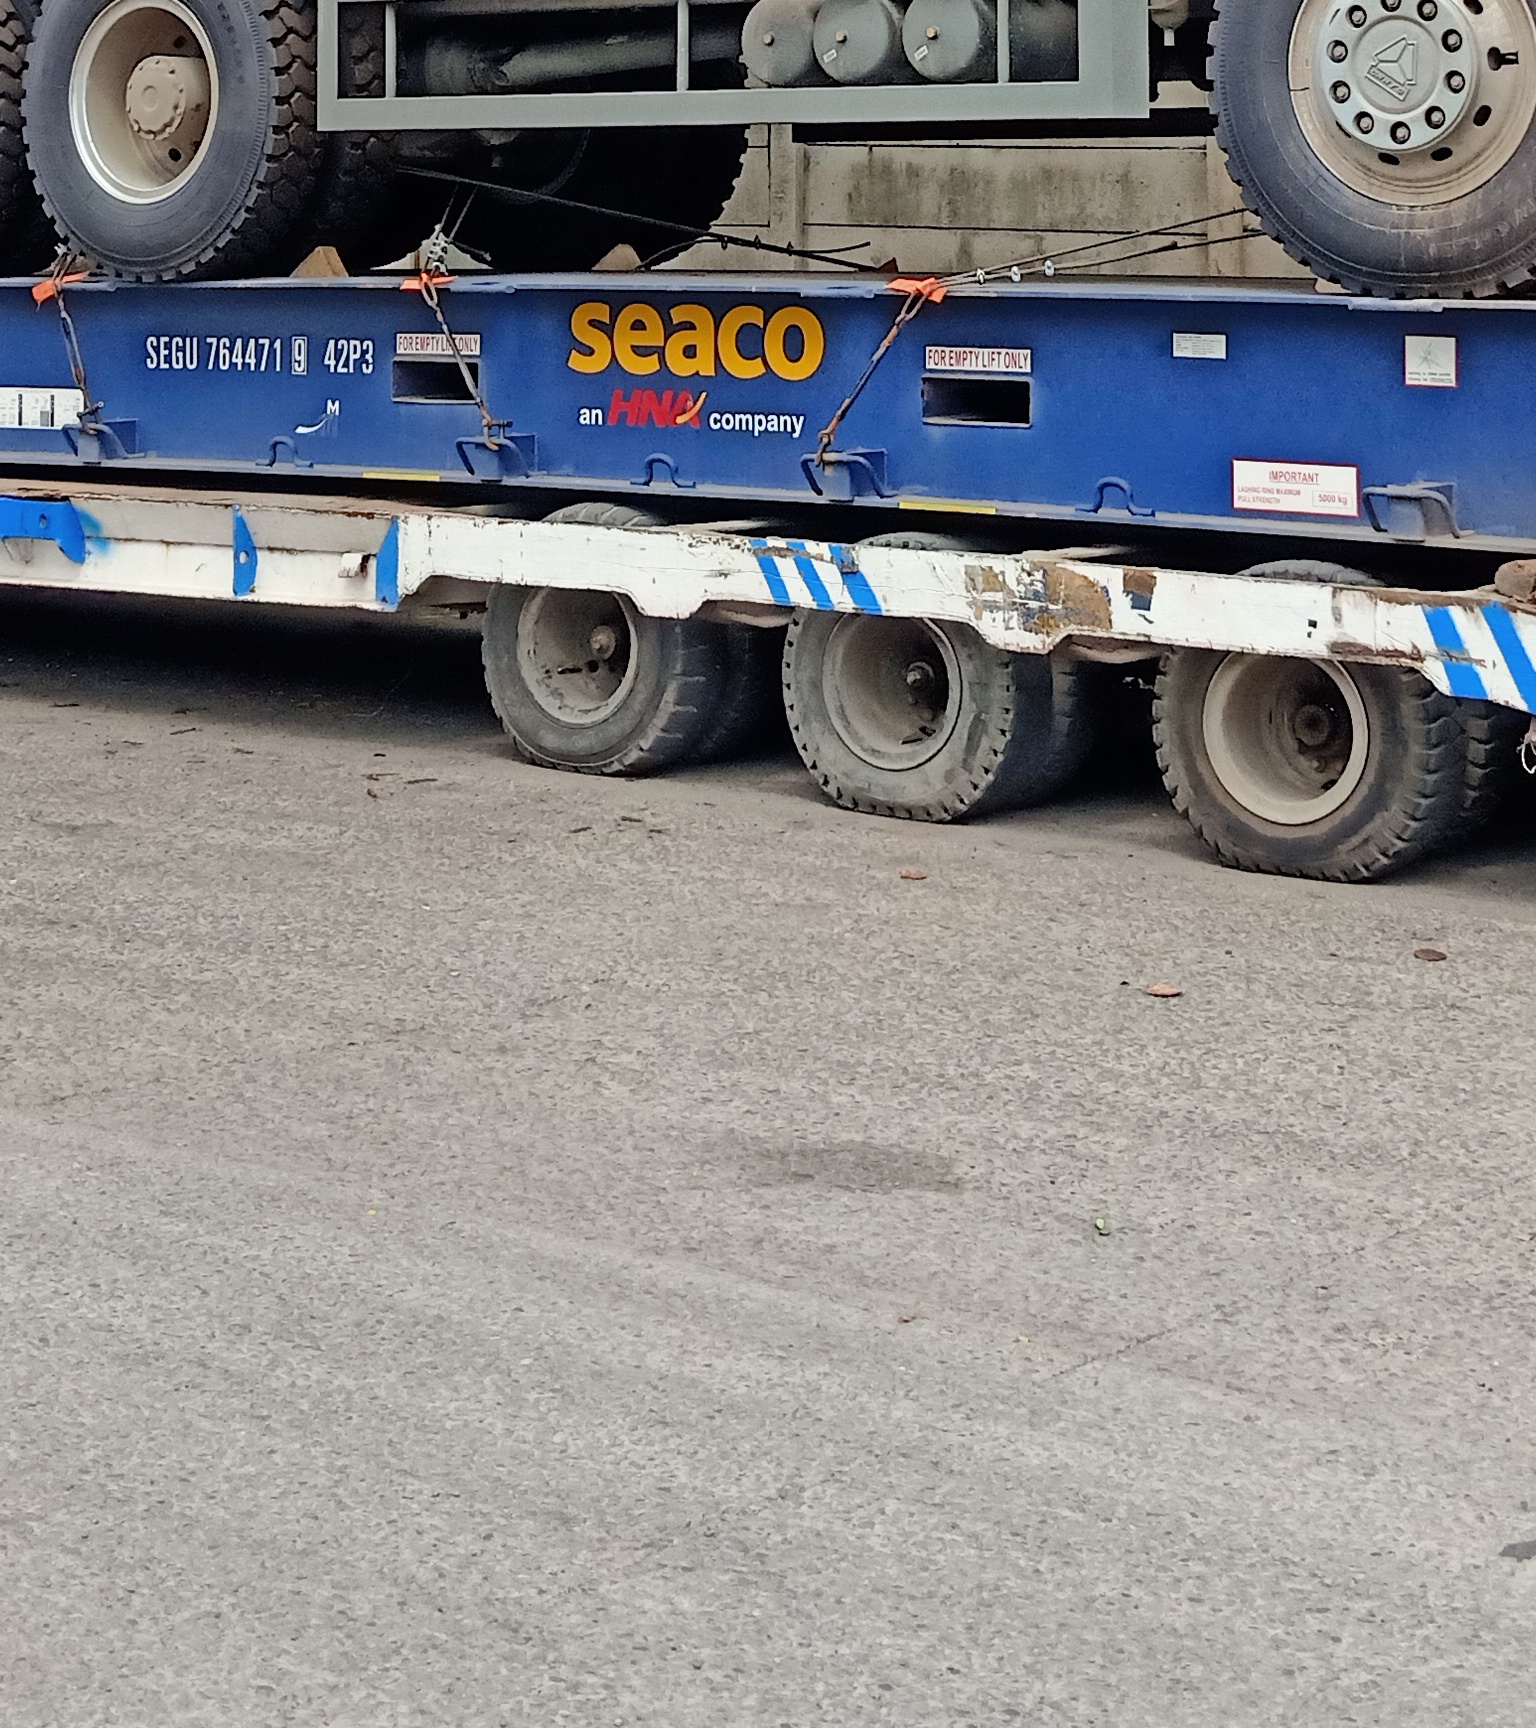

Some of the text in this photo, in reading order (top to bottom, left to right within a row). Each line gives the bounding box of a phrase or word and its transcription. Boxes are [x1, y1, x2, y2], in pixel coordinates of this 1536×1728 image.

[398, 336, 414, 352] FOR
[414, 336, 440, 352] EMPTY
[459, 337, 478, 353] ONLY
[567, 301, 825, 382] seaco
[146, 336, 374, 374] SEGU 764471 9 42P3
[927, 349, 1029, 370] FOR EMPTY LIFT ONLY
[579, 388, 805, 439] an HNA company
[1269, 470, 1319, 483] IMPORTANT
[1318, 493, 1348, 506] 5000 kg
